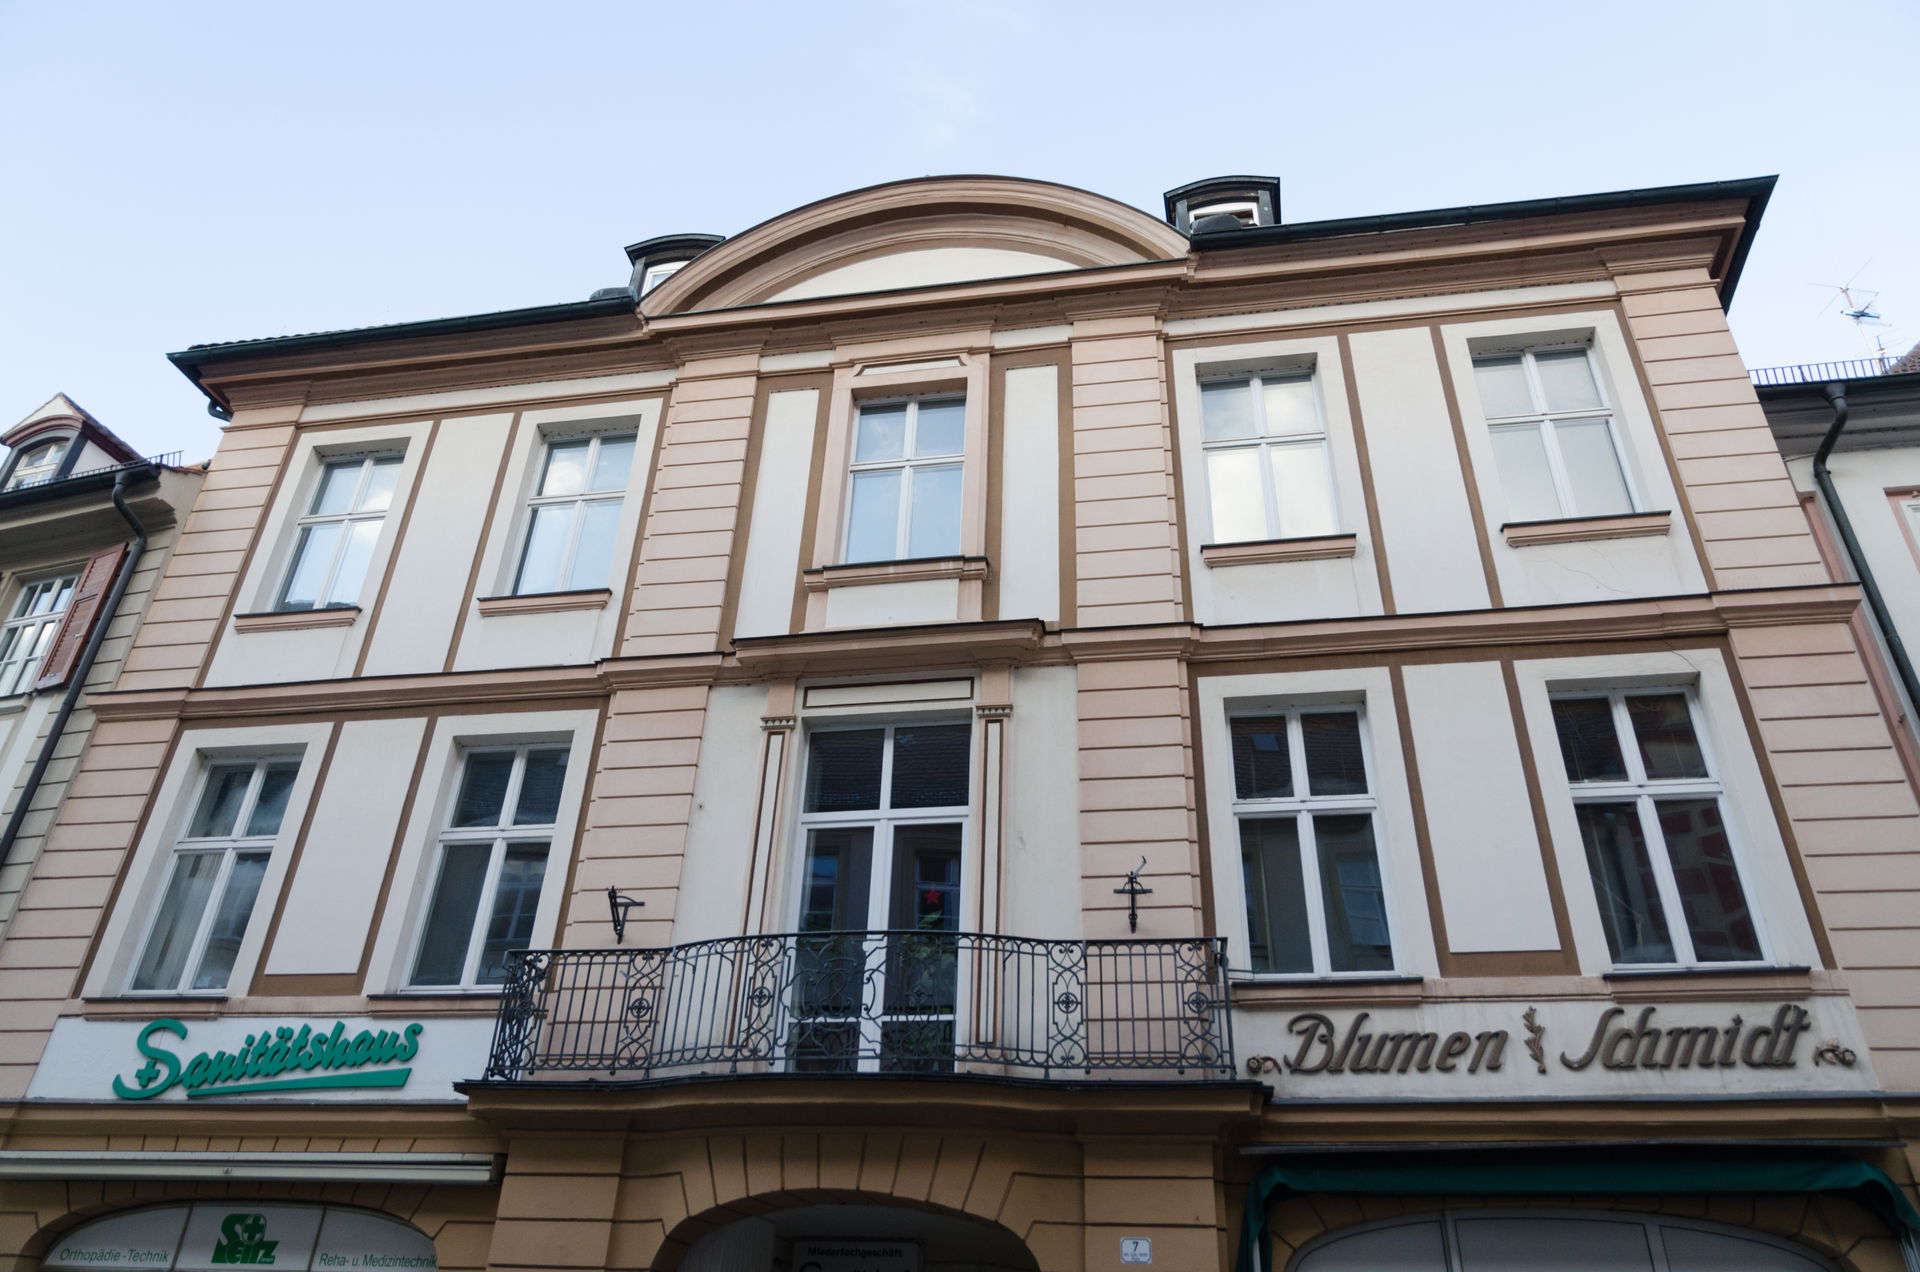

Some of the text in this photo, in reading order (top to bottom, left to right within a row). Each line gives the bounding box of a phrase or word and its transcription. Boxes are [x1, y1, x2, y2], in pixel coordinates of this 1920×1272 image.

[113, 1018, 424, 1099] Sanitätshaus
[1284, 1003, 1812, 1076] Blumen Schmidt
[319, 1252, 349, 1266] Reha-
[362, 1253, 437, 1268] Medizintechnik
[1132, 1240, 1140, 1252] 7
